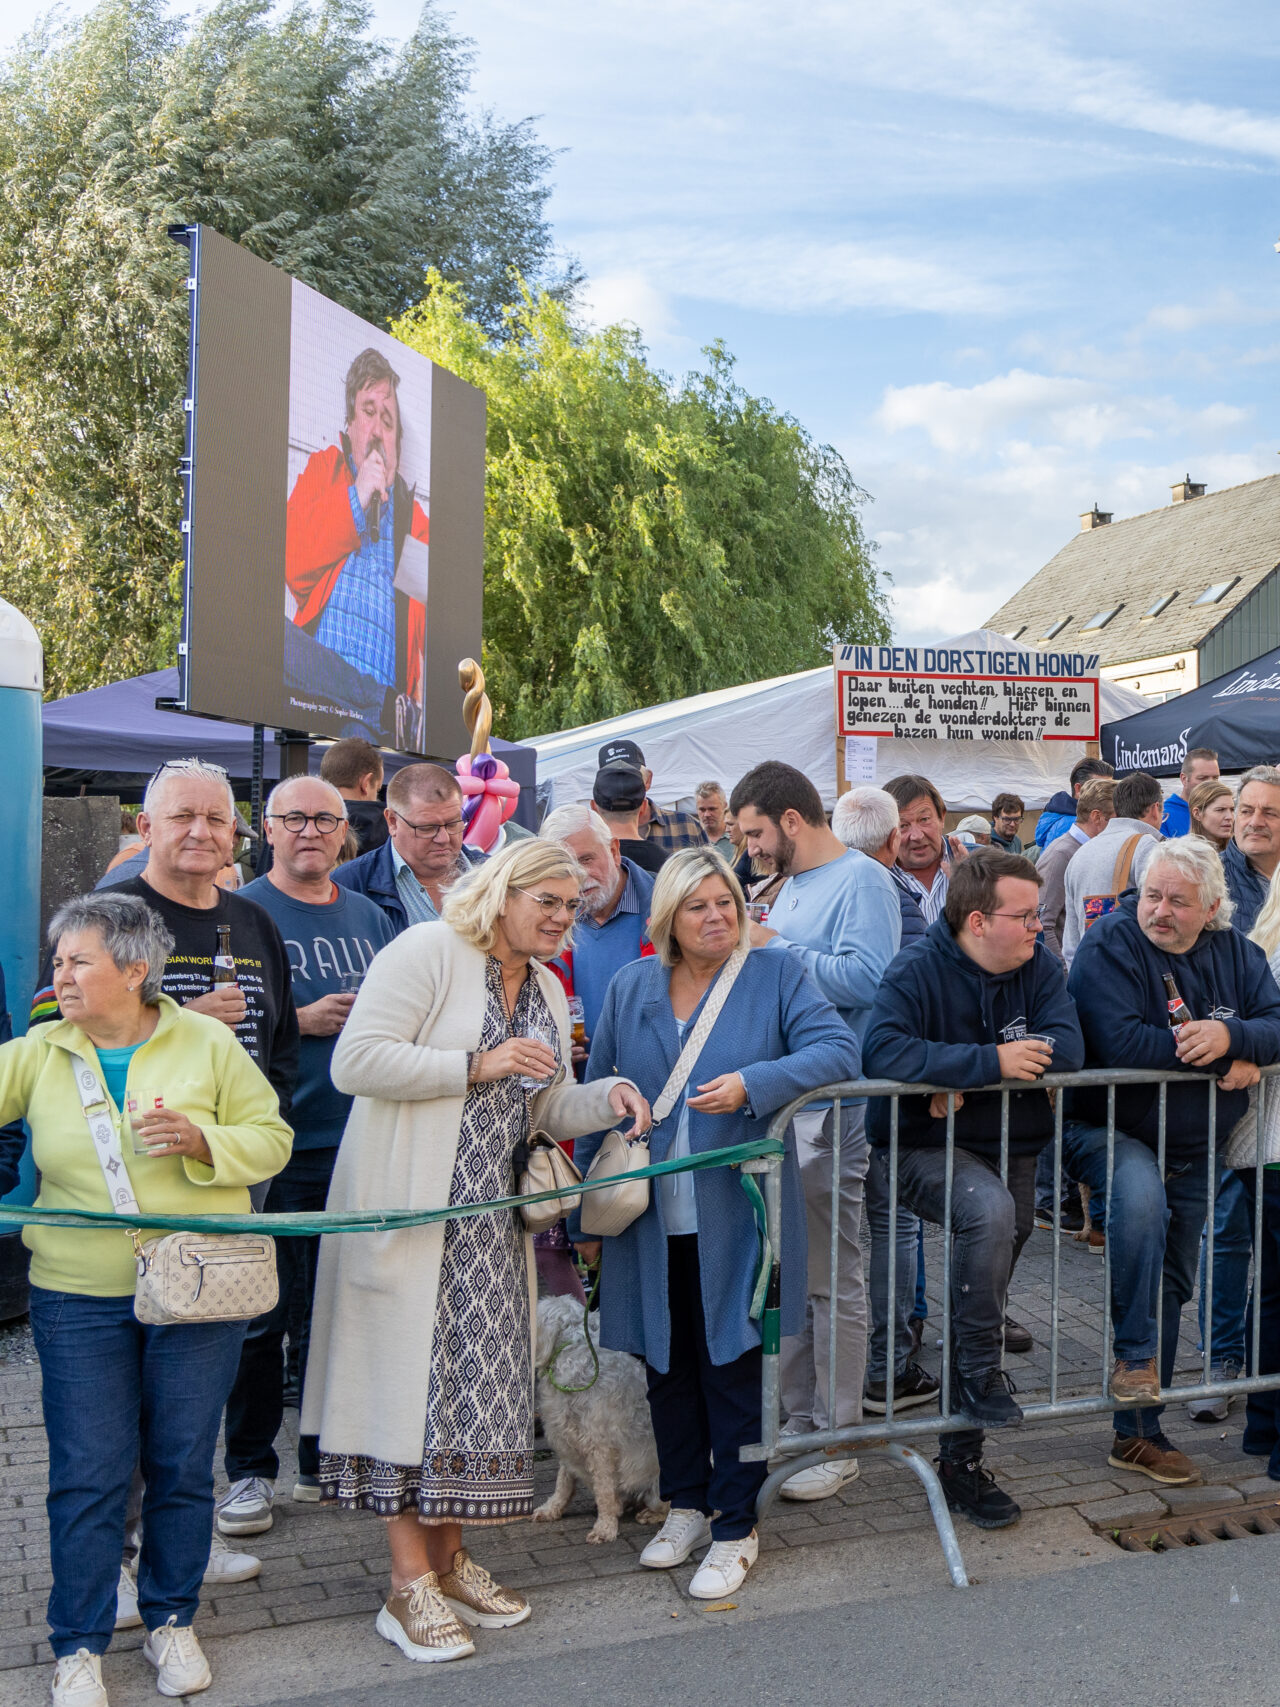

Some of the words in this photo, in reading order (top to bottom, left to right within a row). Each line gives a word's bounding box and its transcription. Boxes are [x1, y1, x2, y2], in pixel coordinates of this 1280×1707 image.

[879, 647, 920, 672] DEN
[924, 648, 1031, 676] DORSTIGEN
[848, 676, 882, 693] Daar
[889, 678, 935, 695] buiten
[941, 681, 998, 699] vechten,
[1003, 682, 1054, 701] blaffen
[1061, 686, 1078, 699] en
[1009, 696, 1039, 712] Hier
[1045, 698, 1091, 713] binnen
[847, 711, 906, 726] genezen
[915, 710, 932, 724] de
[940, 711, 1046, 727] wonderdokters
[1055, 712, 1071, 727] de
[894, 723, 937, 740] bazen
[947, 725, 974, 741] hun
[188, 956, 213, 965] WORL
